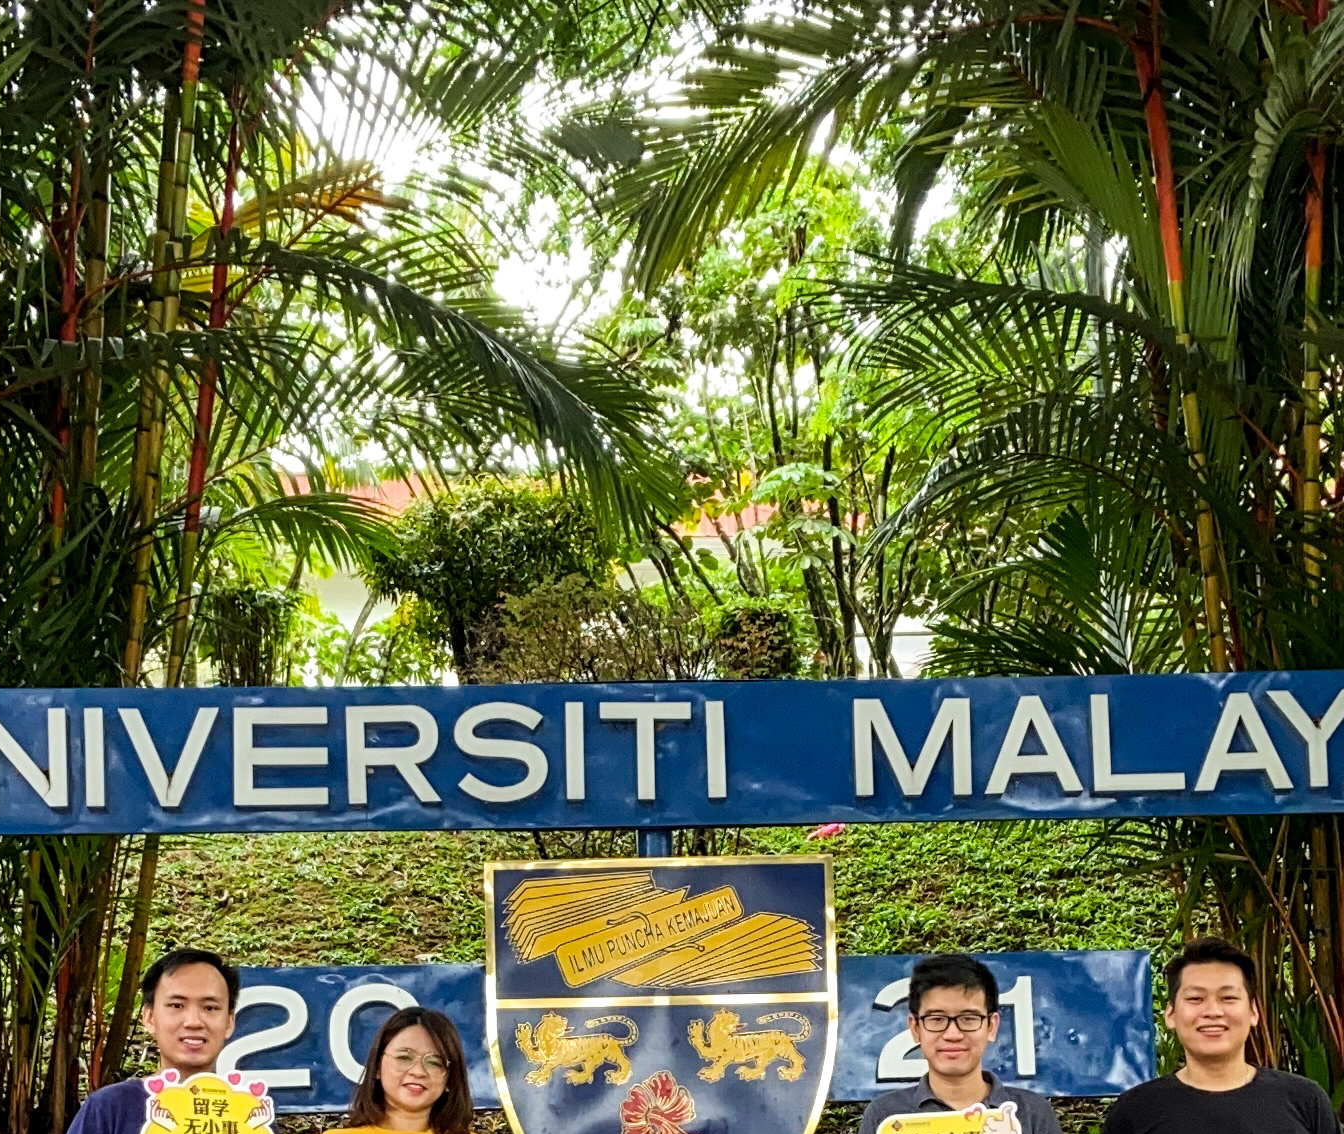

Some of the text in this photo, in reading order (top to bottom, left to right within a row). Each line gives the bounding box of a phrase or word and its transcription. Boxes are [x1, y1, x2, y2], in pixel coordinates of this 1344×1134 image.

[567, 894, 736, 975] ILMU PUNCHA KEMAJUAN
[192, 1097, 230, 1118] 留学
